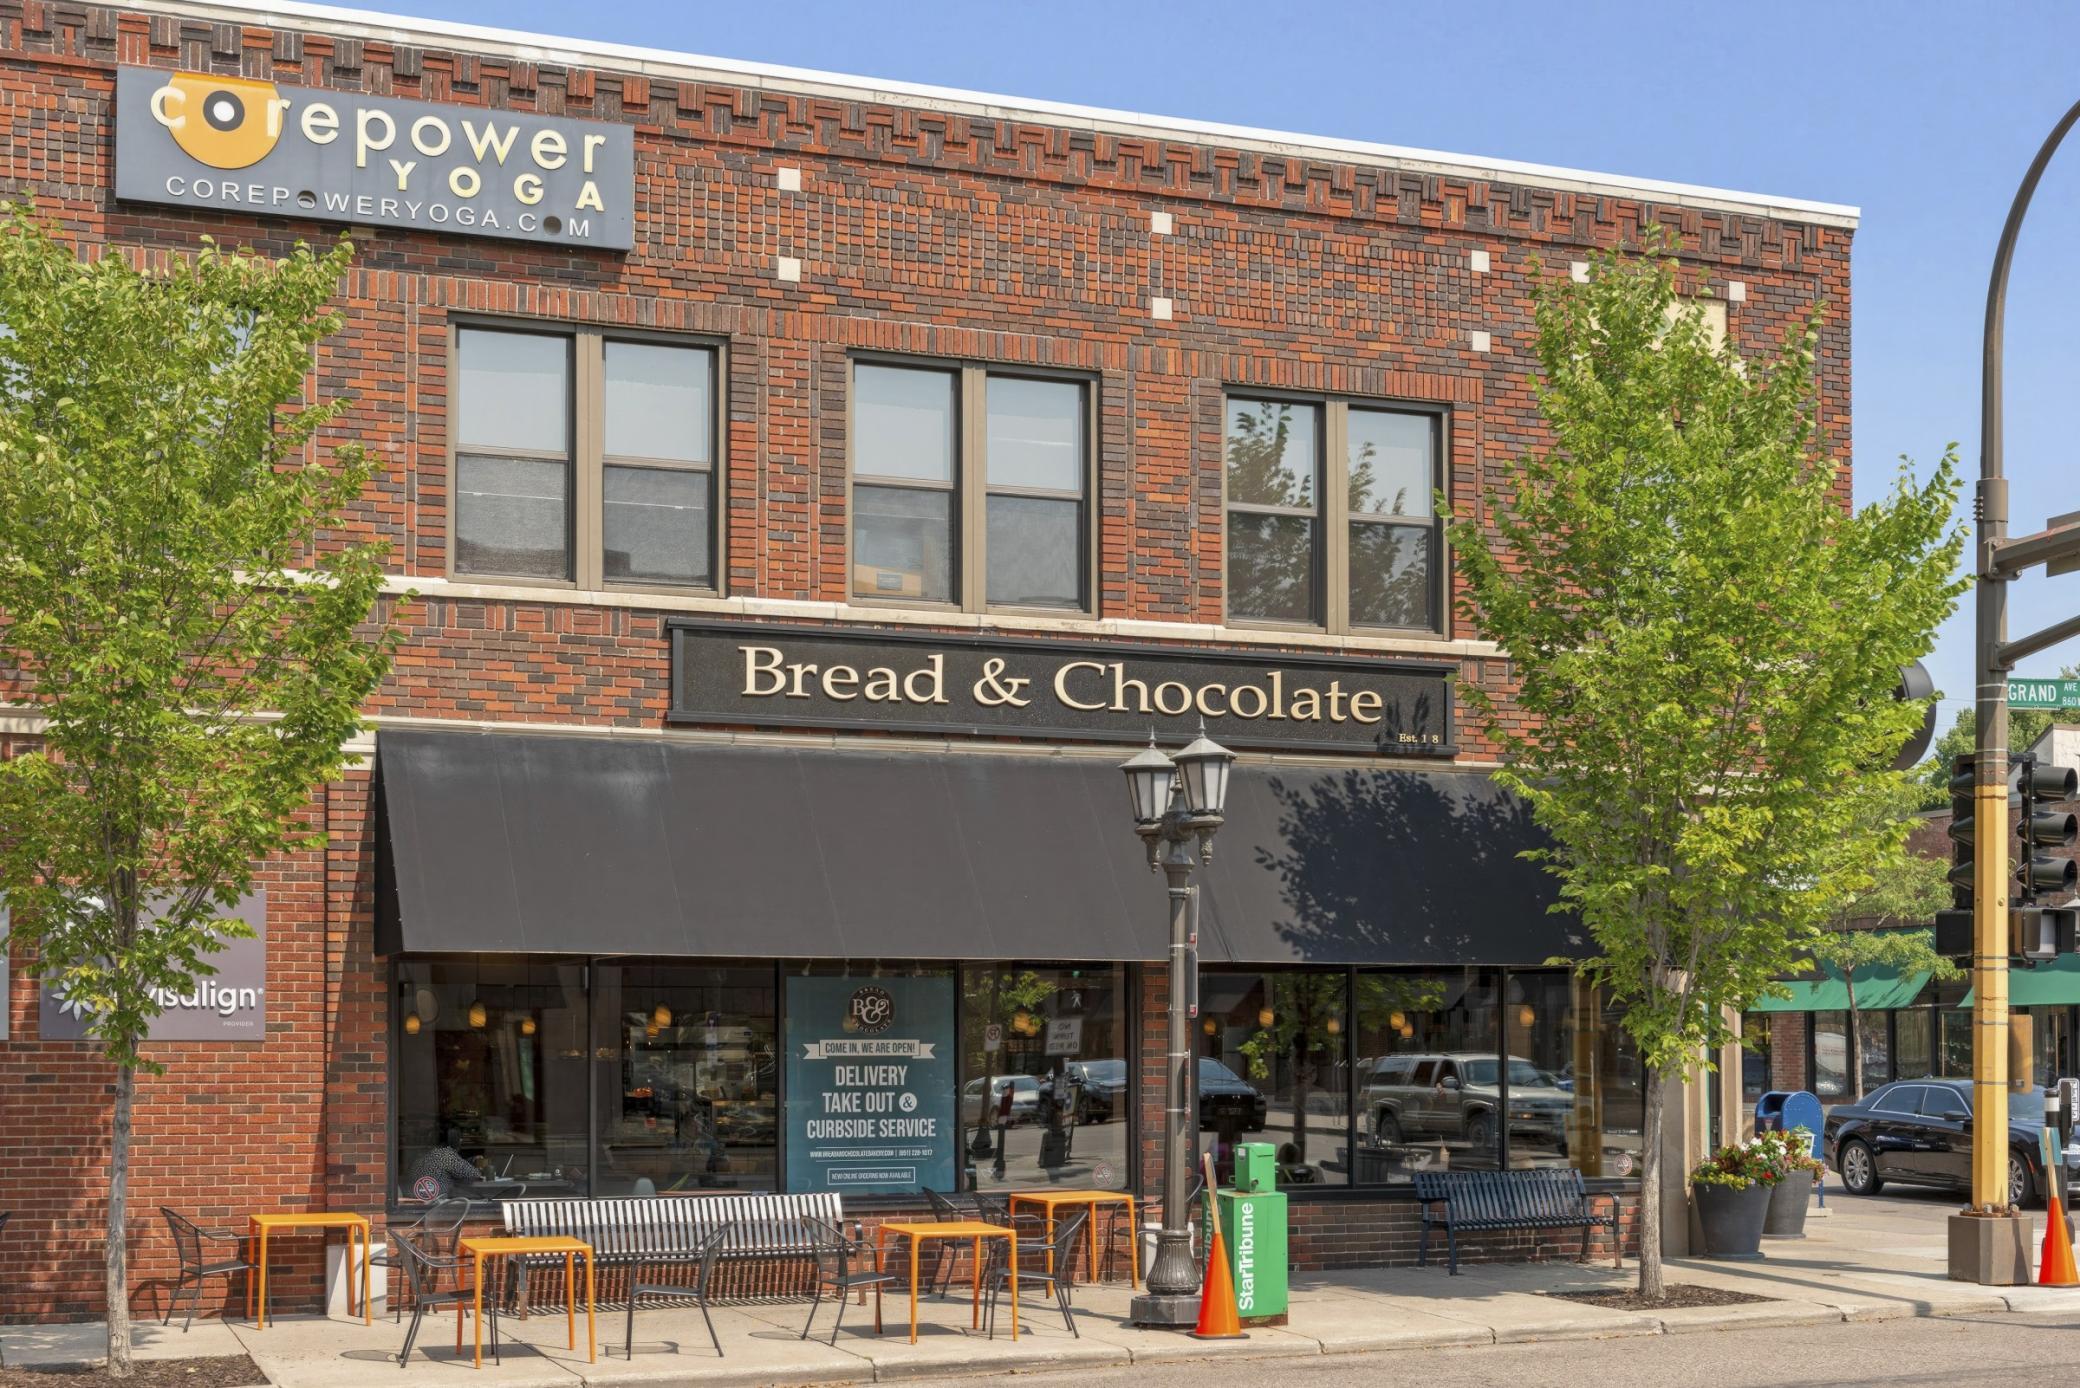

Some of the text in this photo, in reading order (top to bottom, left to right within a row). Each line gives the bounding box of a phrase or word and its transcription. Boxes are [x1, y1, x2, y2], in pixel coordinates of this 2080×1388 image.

[389, 159, 605, 212] YOGA
[738, 645, 1383, 724] Bread & Chocolate
[2009, 684, 2057, 702] GRAND
[2064, 682, 2078, 692] AVE
[112, 980, 256, 1016] visalign
[825, 1041, 916, 1054] COME IN, WE ARE OPEN!
[836, 1065, 908, 1086] DELIVERY
[822, 1092, 862, 1113] TAKE
[866, 1092, 896, 1113] OUT
[807, 1118, 937, 1139] CURBSIDE SERVICE
[1238, 1201, 1255, 1311] StarTribune
